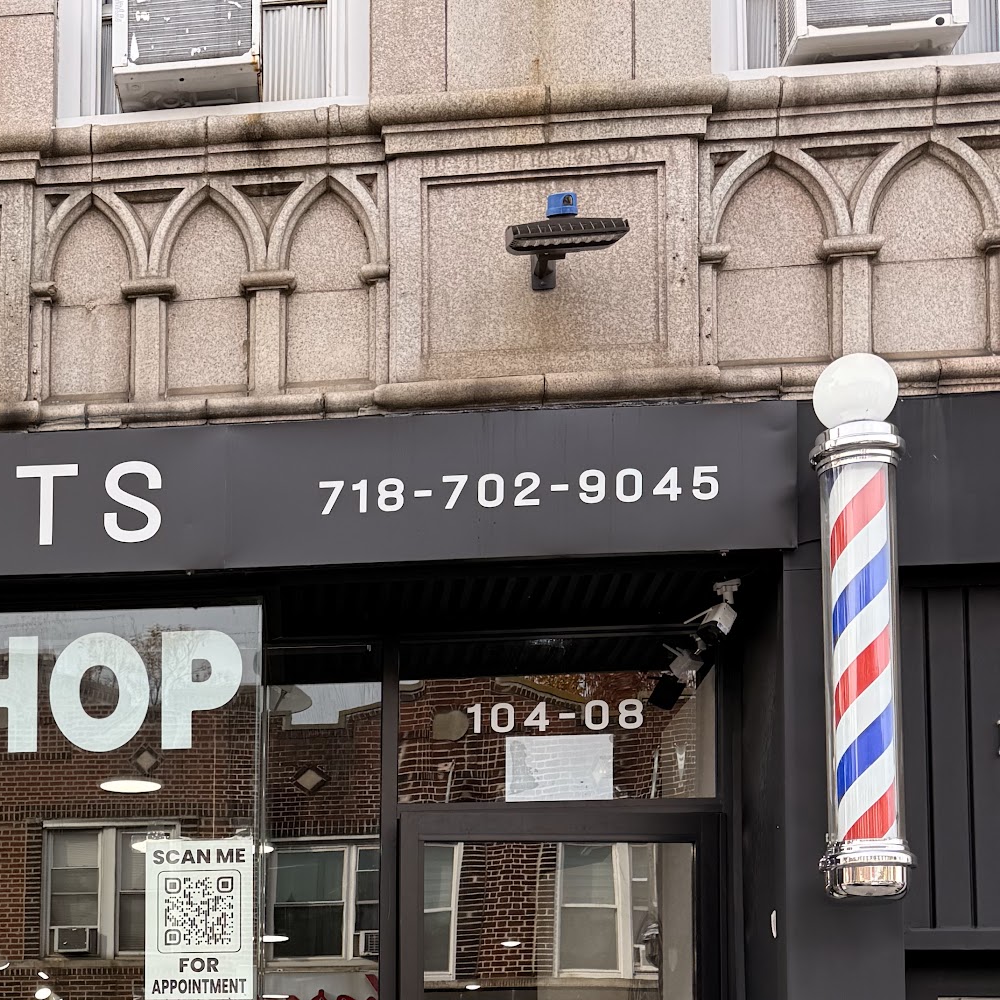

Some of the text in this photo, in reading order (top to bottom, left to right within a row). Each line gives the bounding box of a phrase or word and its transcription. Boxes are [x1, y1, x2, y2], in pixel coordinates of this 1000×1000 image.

[319, 465, 720, 515] 718-702-9045
[466, 698, 645, 735] 104-08
[153, 847, 246, 865] SCAN ME
[179, 957, 219, 973] FOR
[152, 978, 247, 995] APPOINTMENT
